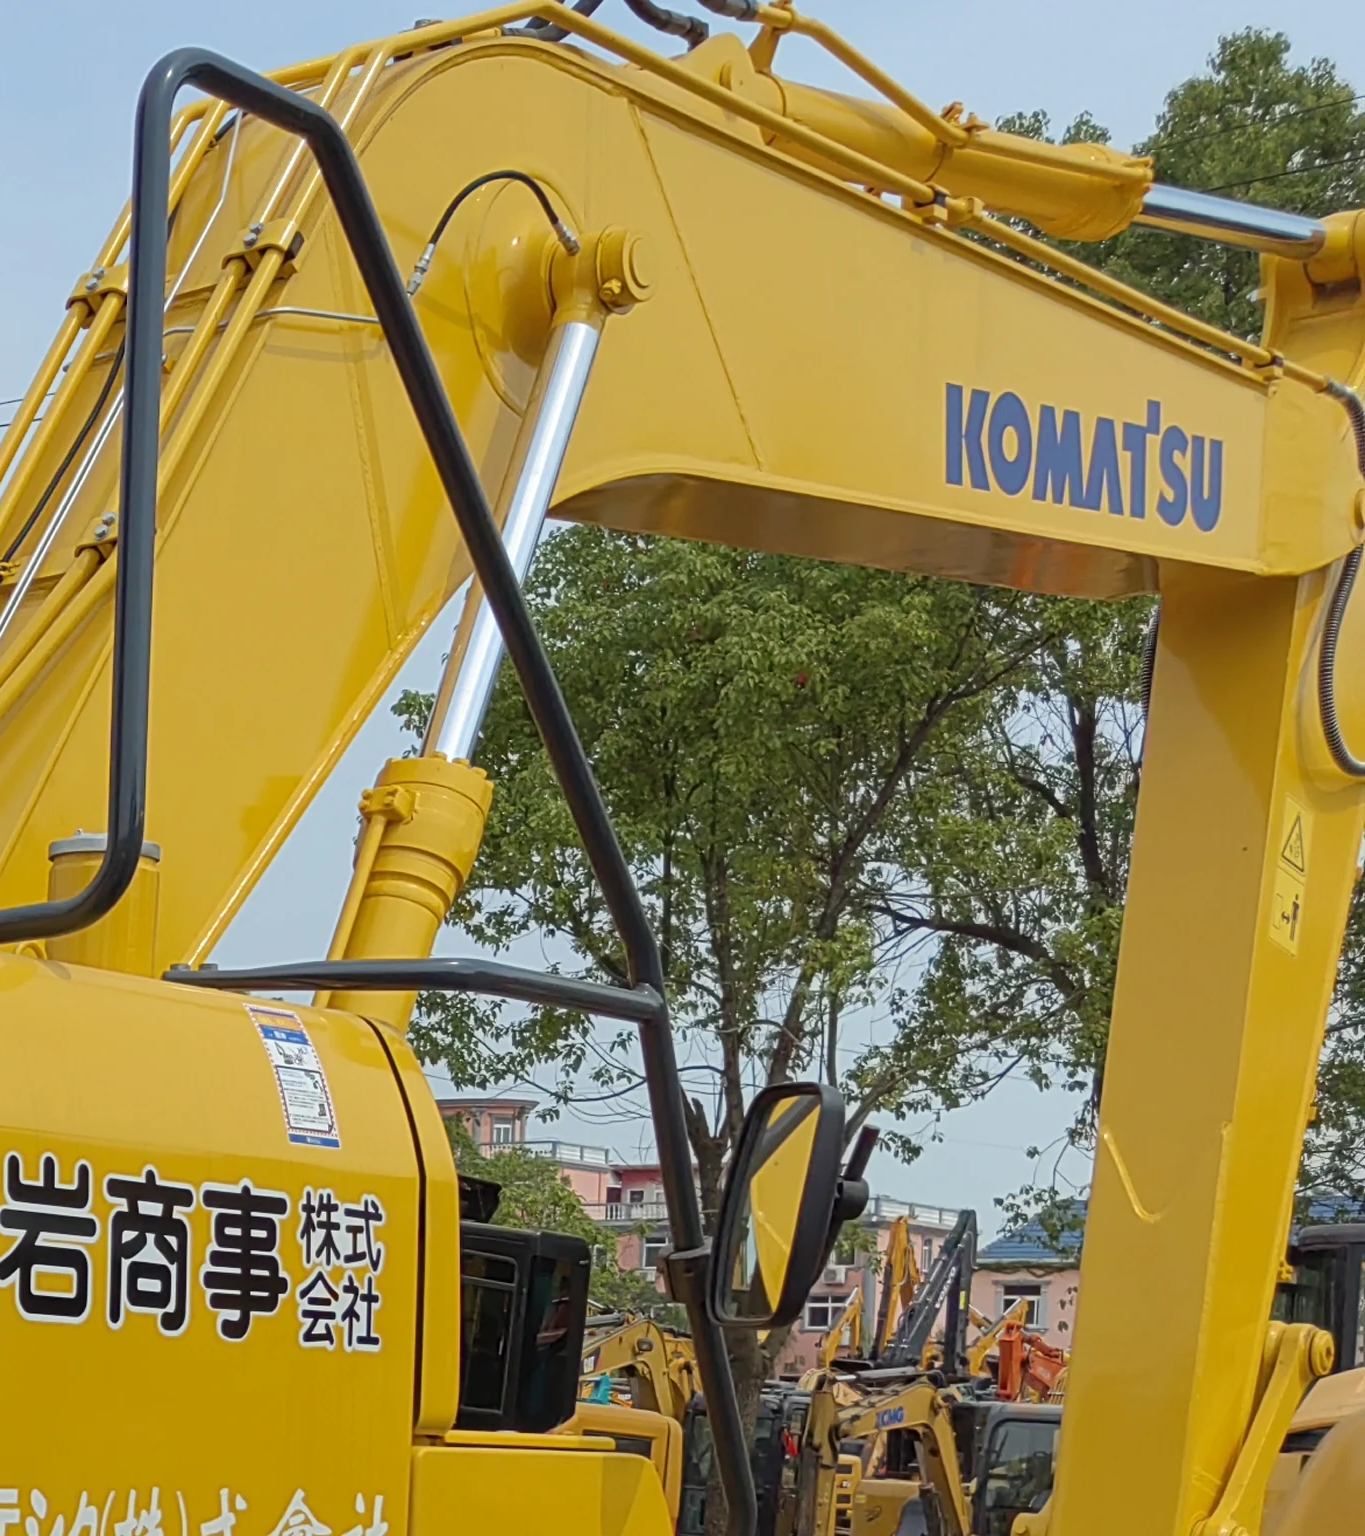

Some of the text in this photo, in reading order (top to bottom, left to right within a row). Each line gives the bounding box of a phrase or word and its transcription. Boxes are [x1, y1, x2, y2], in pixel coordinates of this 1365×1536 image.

[946, 383, 1223, 532] KOMATSU
[298, 1187, 384, 1272] 株式
[295, 1272, 383, 1350] 会社
